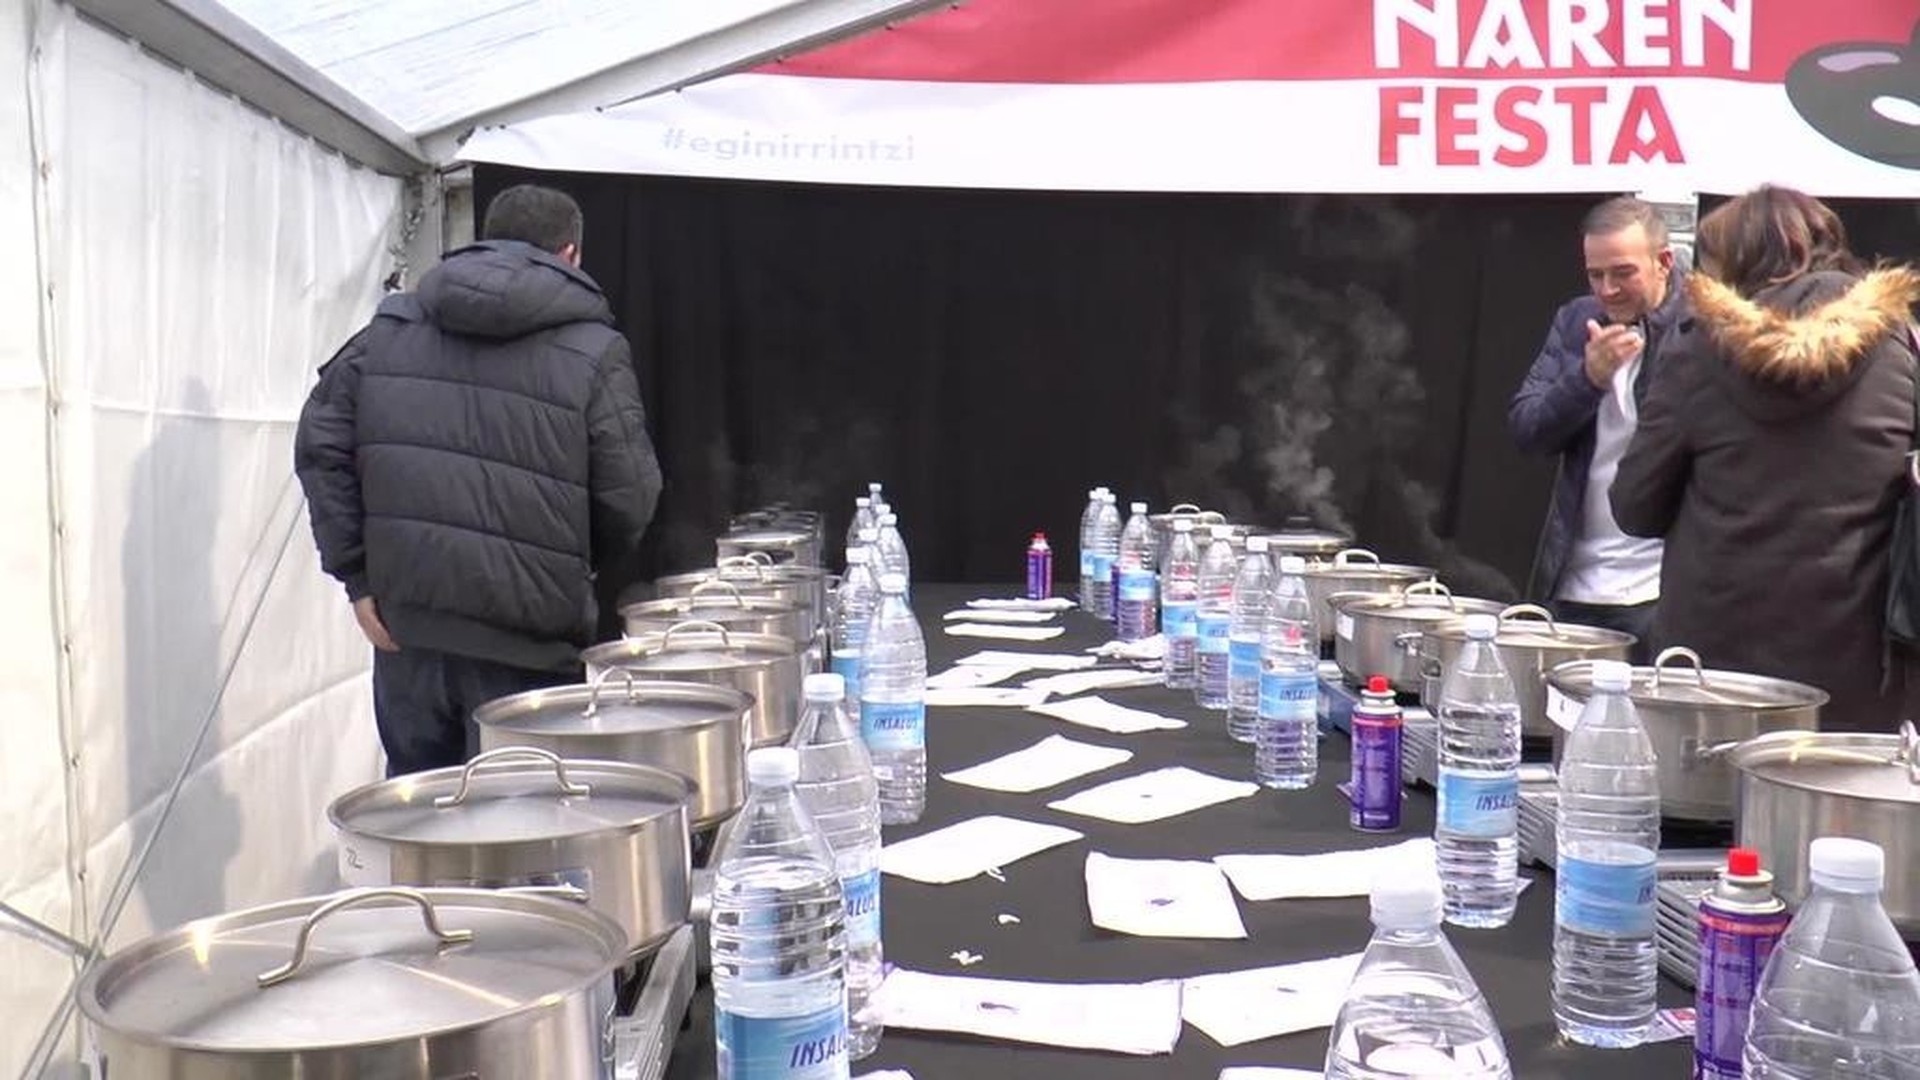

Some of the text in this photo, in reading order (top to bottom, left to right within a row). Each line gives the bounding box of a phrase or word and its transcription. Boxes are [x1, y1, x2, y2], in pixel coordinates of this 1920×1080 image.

[1373, 0, 1751, 71] NAREN
[663, 127, 914, 161] #eginirrintzi
[1378, 86, 1686, 167] FESTA
